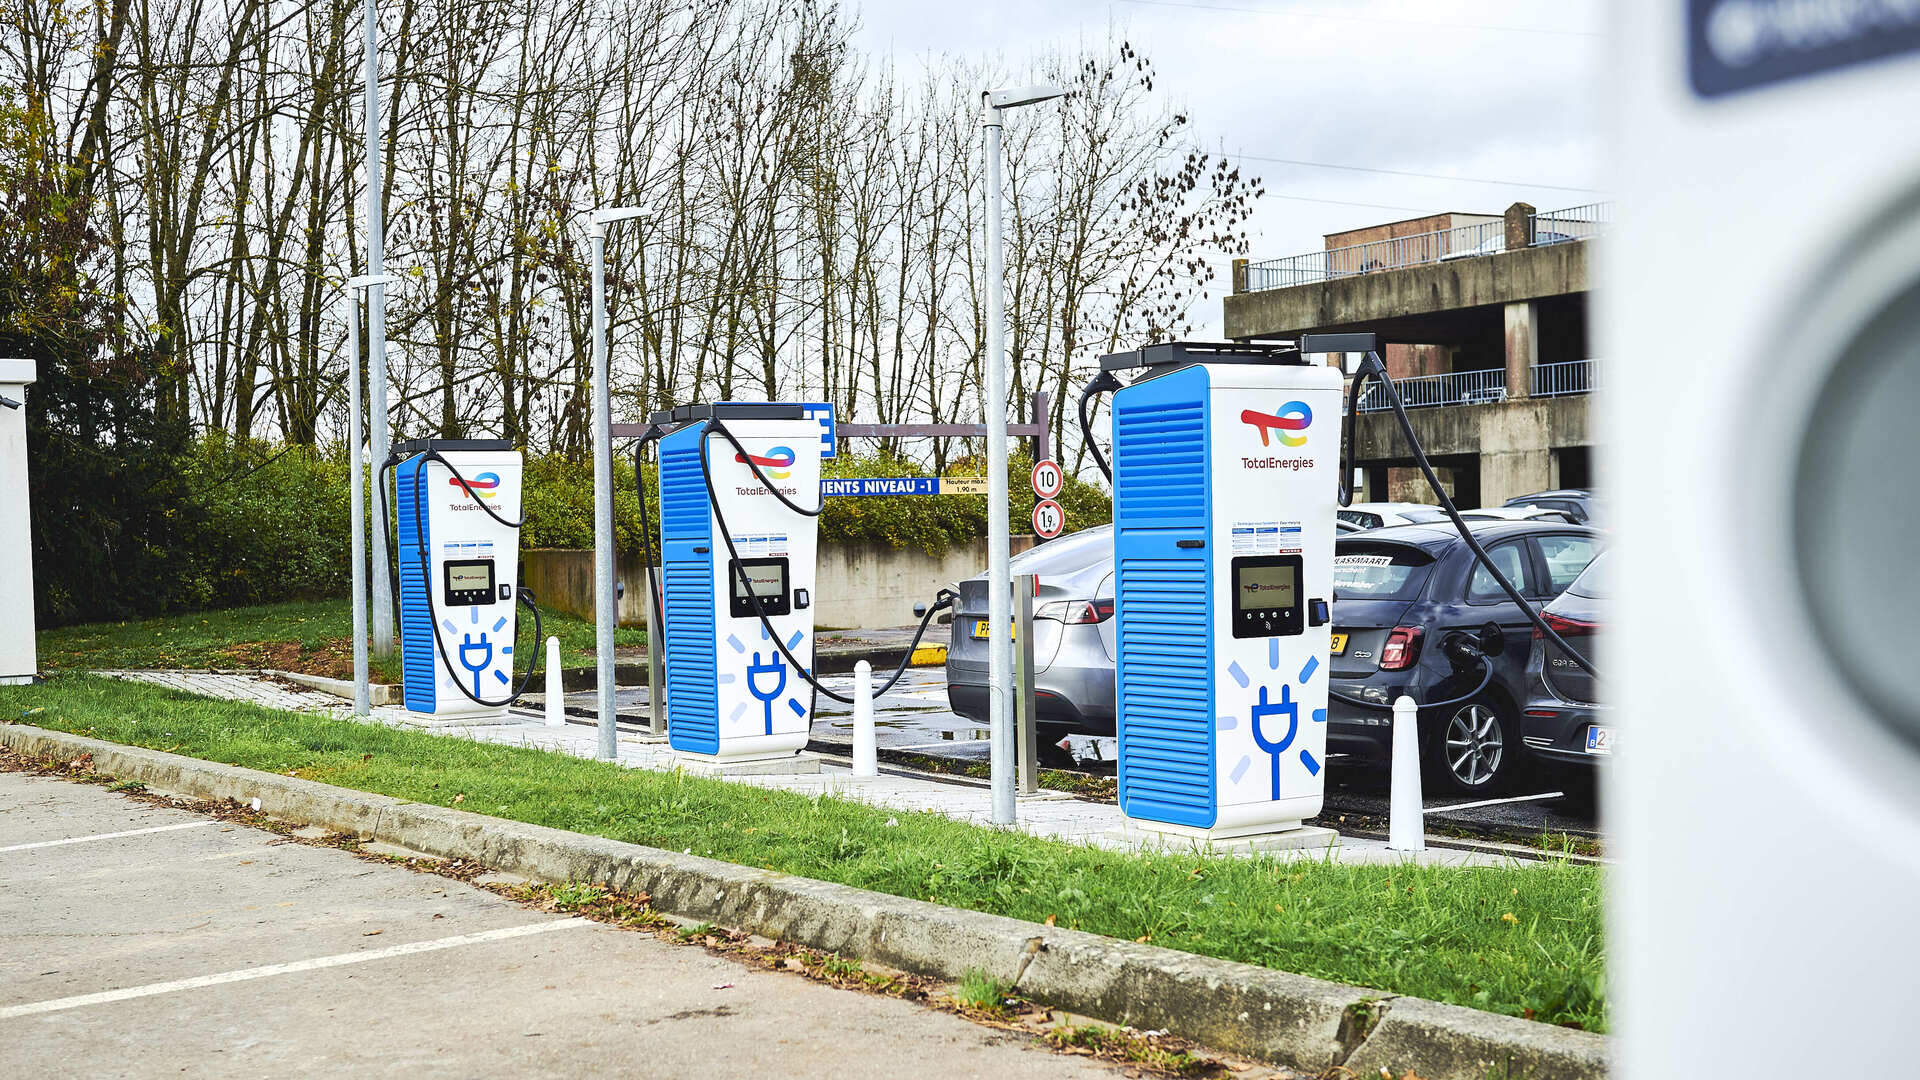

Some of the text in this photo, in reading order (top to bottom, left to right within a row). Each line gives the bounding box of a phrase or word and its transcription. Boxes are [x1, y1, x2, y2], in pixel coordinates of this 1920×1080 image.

[1241, 456, 1314, 472] TotalEnergies
[822, 479, 932, 494] IENTS NIVEAU -1
[1040, 471, 1055, 488] 10
[735, 486, 797, 497] TotalEnegies
